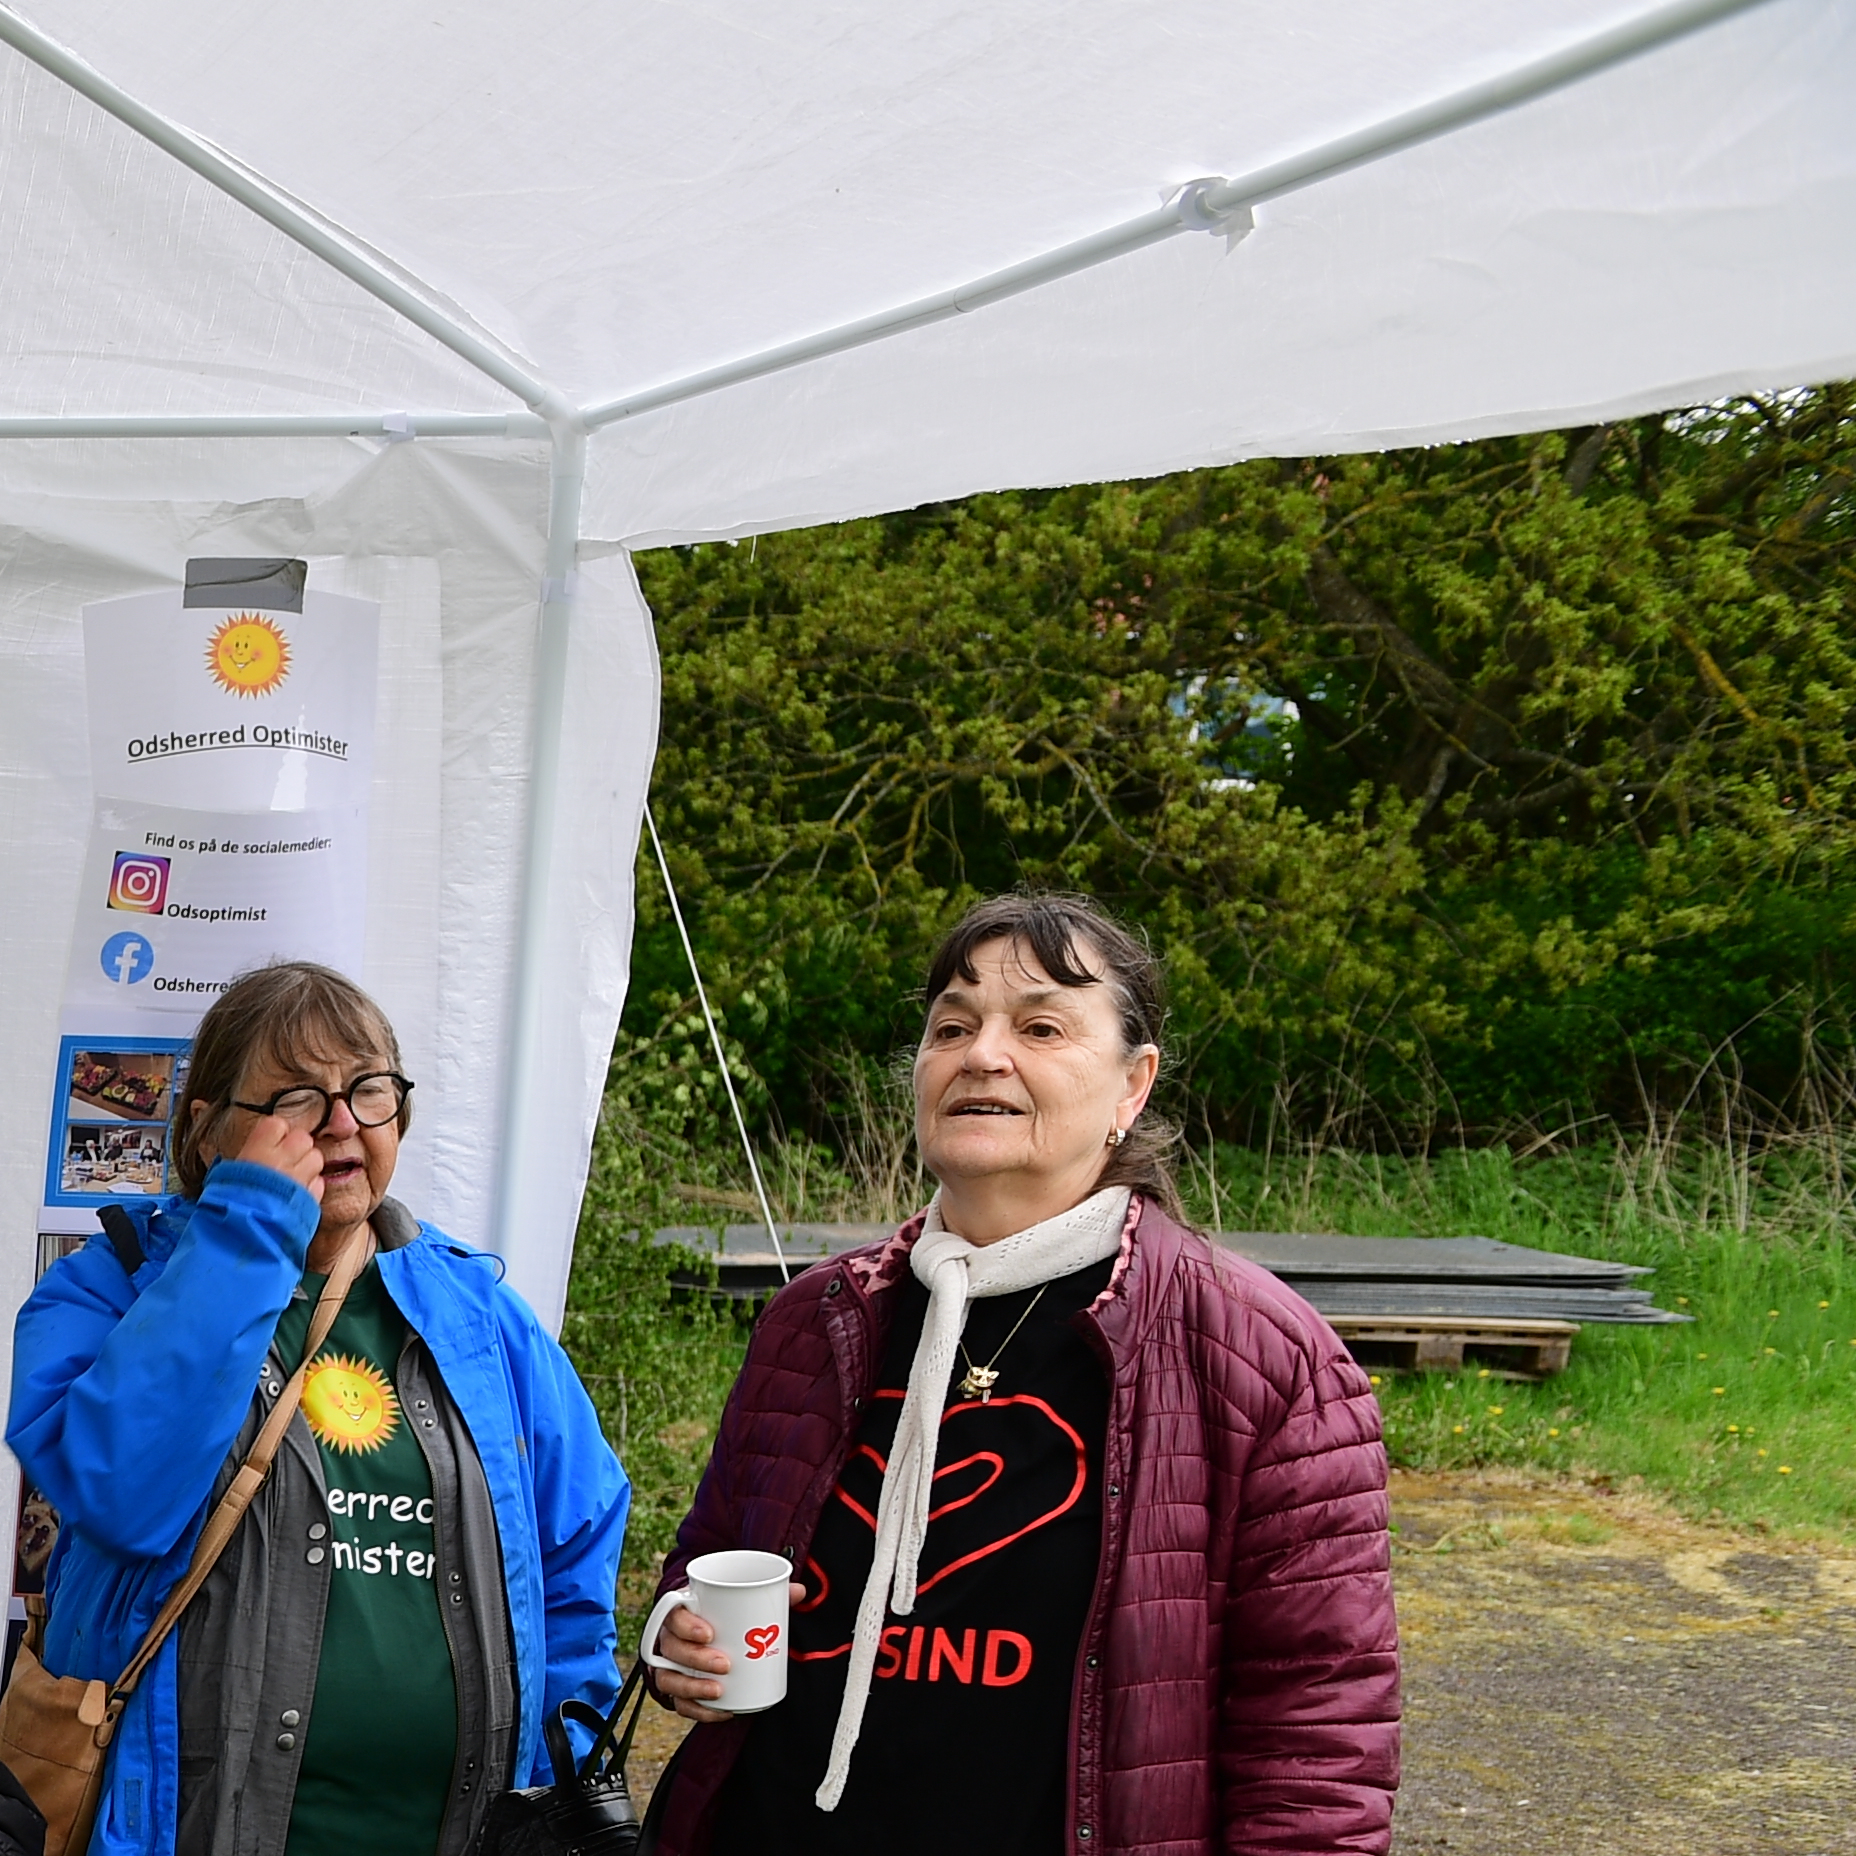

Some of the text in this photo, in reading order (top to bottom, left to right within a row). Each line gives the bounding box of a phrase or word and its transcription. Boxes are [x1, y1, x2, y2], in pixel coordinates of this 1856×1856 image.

[127, 724, 349, 758] Odsherred Optimister
[145, 832, 332, 855] Find os på de socialemedier:
[167, 904, 268, 923] Odsoptimist
[154, 977, 231, 993] Odsherre
[873, 1625, 1033, 1687] SIND
